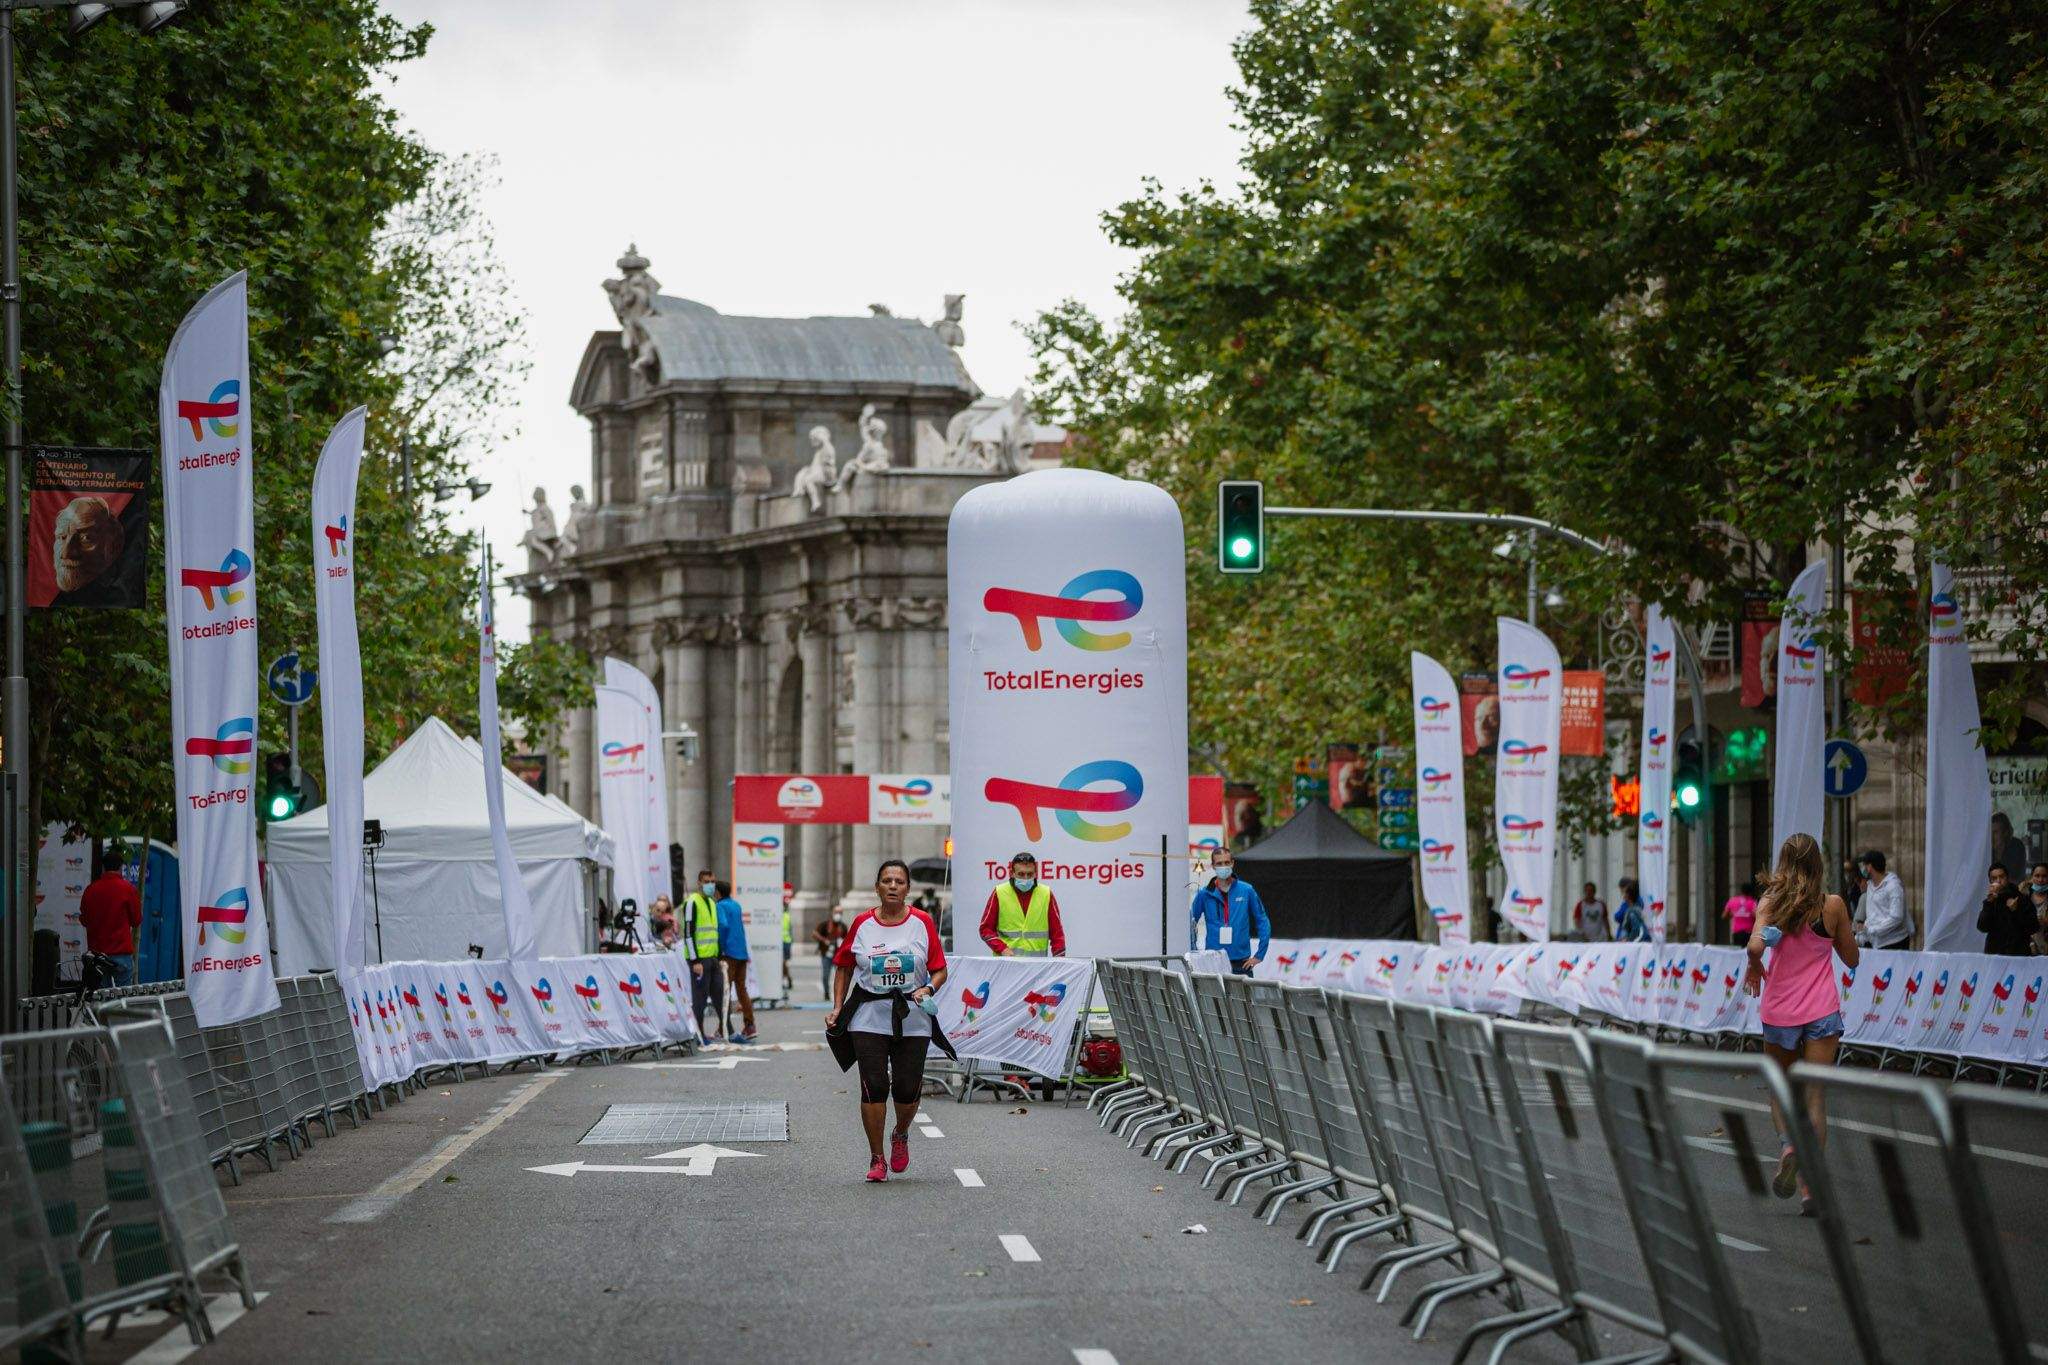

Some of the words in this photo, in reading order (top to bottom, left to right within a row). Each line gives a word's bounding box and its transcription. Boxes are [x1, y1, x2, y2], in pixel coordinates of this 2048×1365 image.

[36, 461, 88, 470] CENTENARIO
[52, 471, 104, 479] NACIMIENTO
[105, 472, 117, 480] DE
[36, 478, 80, 487] FERNANDO
[984, 668, 1144, 694] TotalEnergies
[881, 973, 906, 986] 1129
